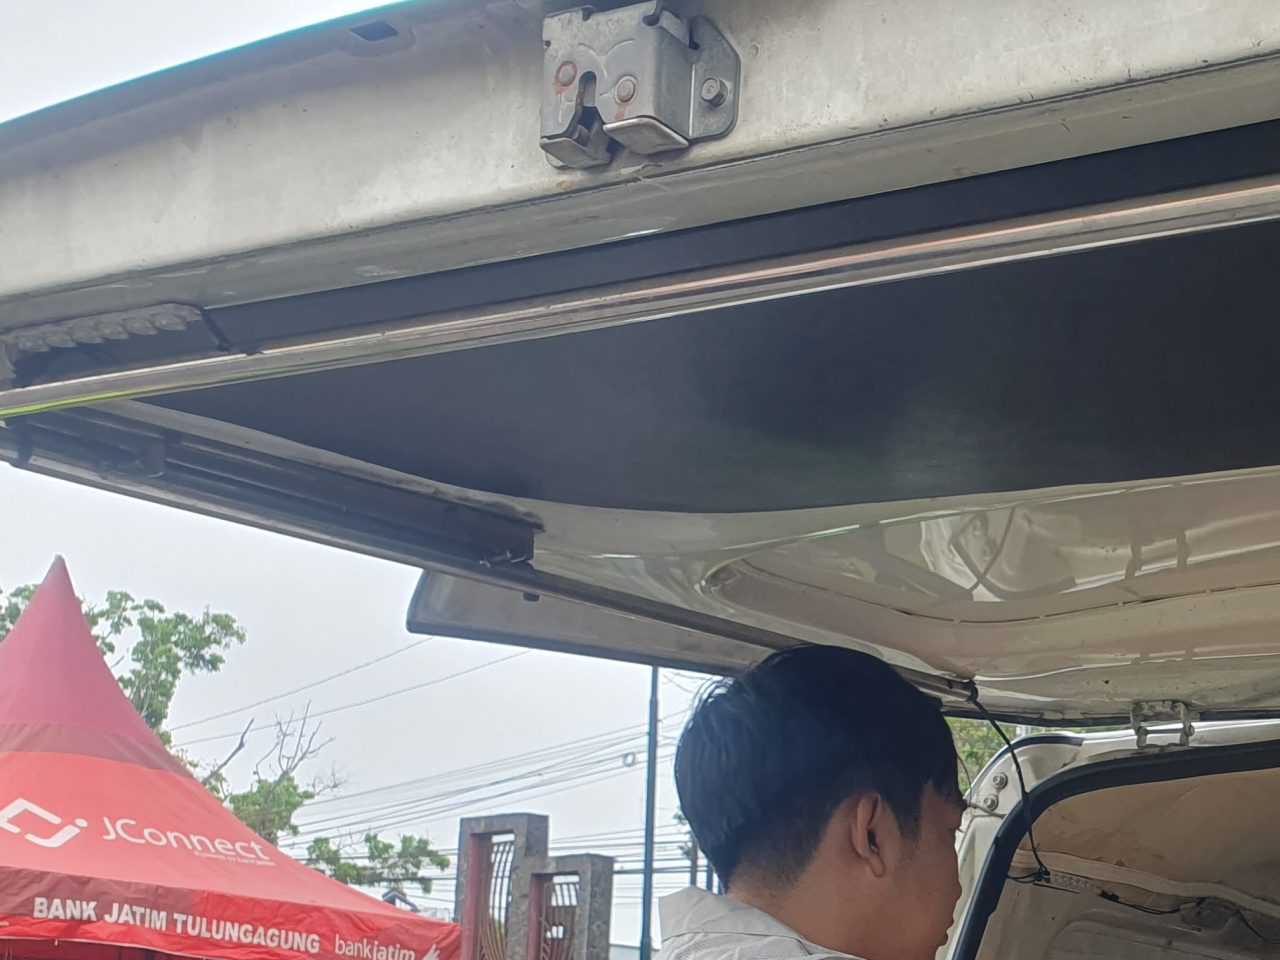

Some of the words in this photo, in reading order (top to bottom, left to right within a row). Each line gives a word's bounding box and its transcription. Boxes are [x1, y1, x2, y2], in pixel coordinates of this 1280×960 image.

[102, 816, 271, 860] JConnect
[33, 897, 97, 921] BANK
[104, 903, 167, 931] JATIM
[173, 913, 320, 953] TULUNGAGUNG
